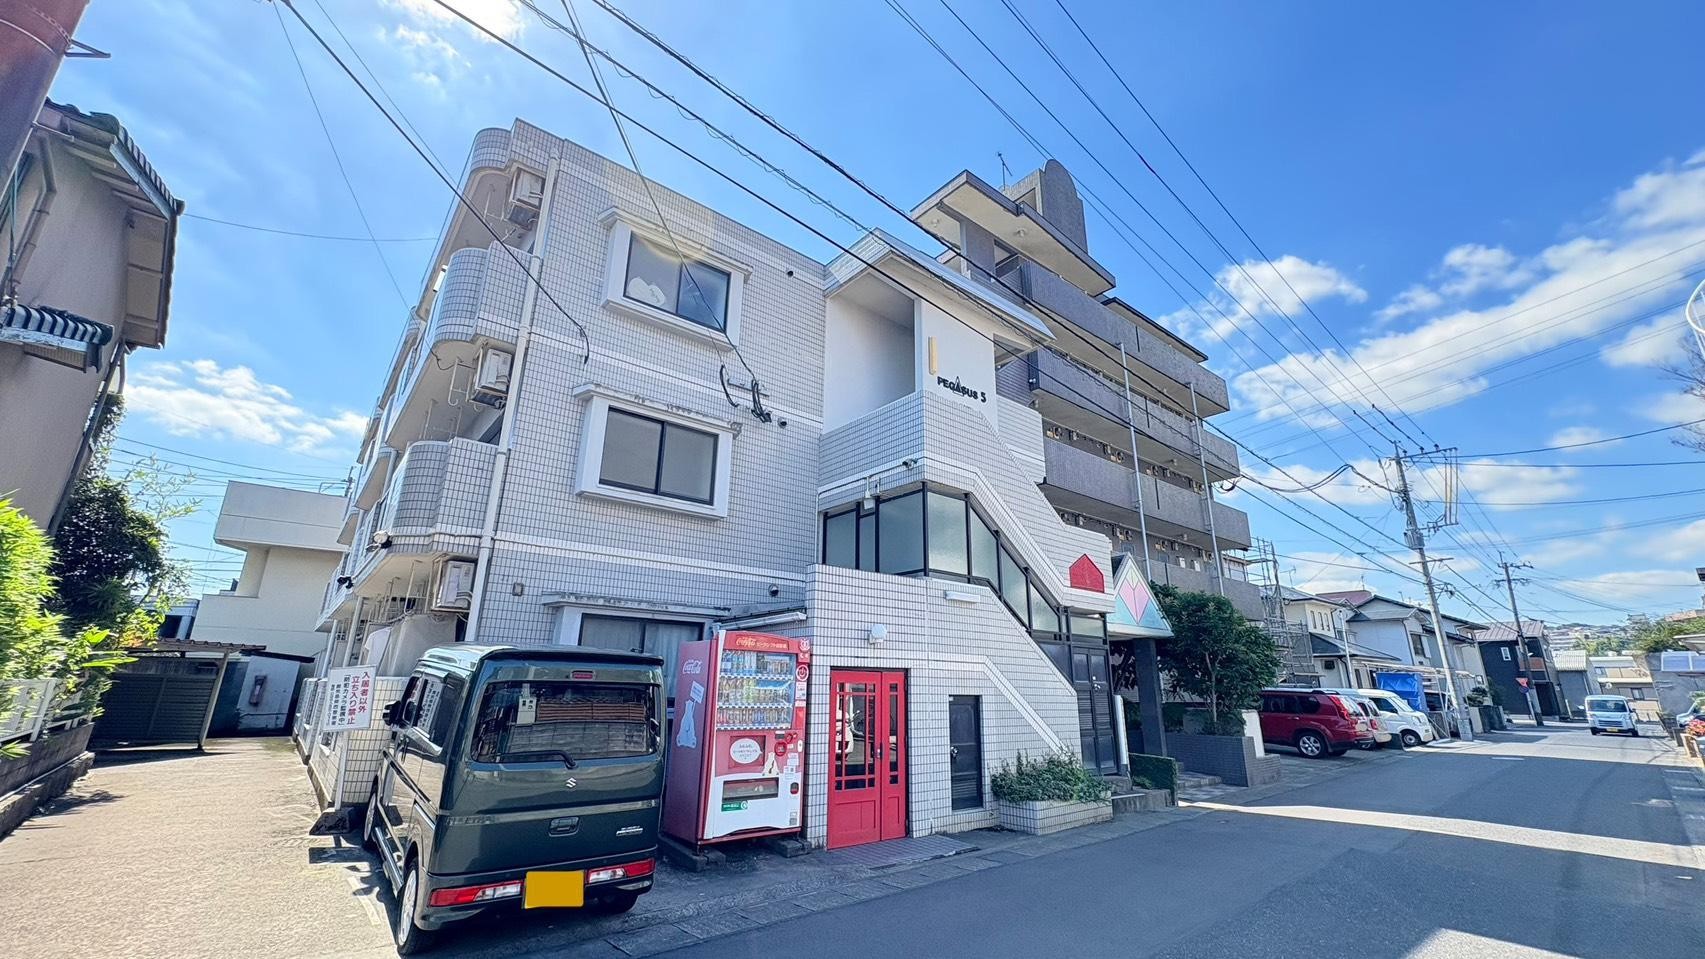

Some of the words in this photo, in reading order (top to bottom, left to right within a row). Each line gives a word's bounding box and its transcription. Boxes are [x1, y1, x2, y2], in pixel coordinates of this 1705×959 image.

[937, 376, 979, 400] PEGASUS
[347, 676, 360, 725] 立ち入り禁止
[358, 671, 370, 713] 入居者以外
